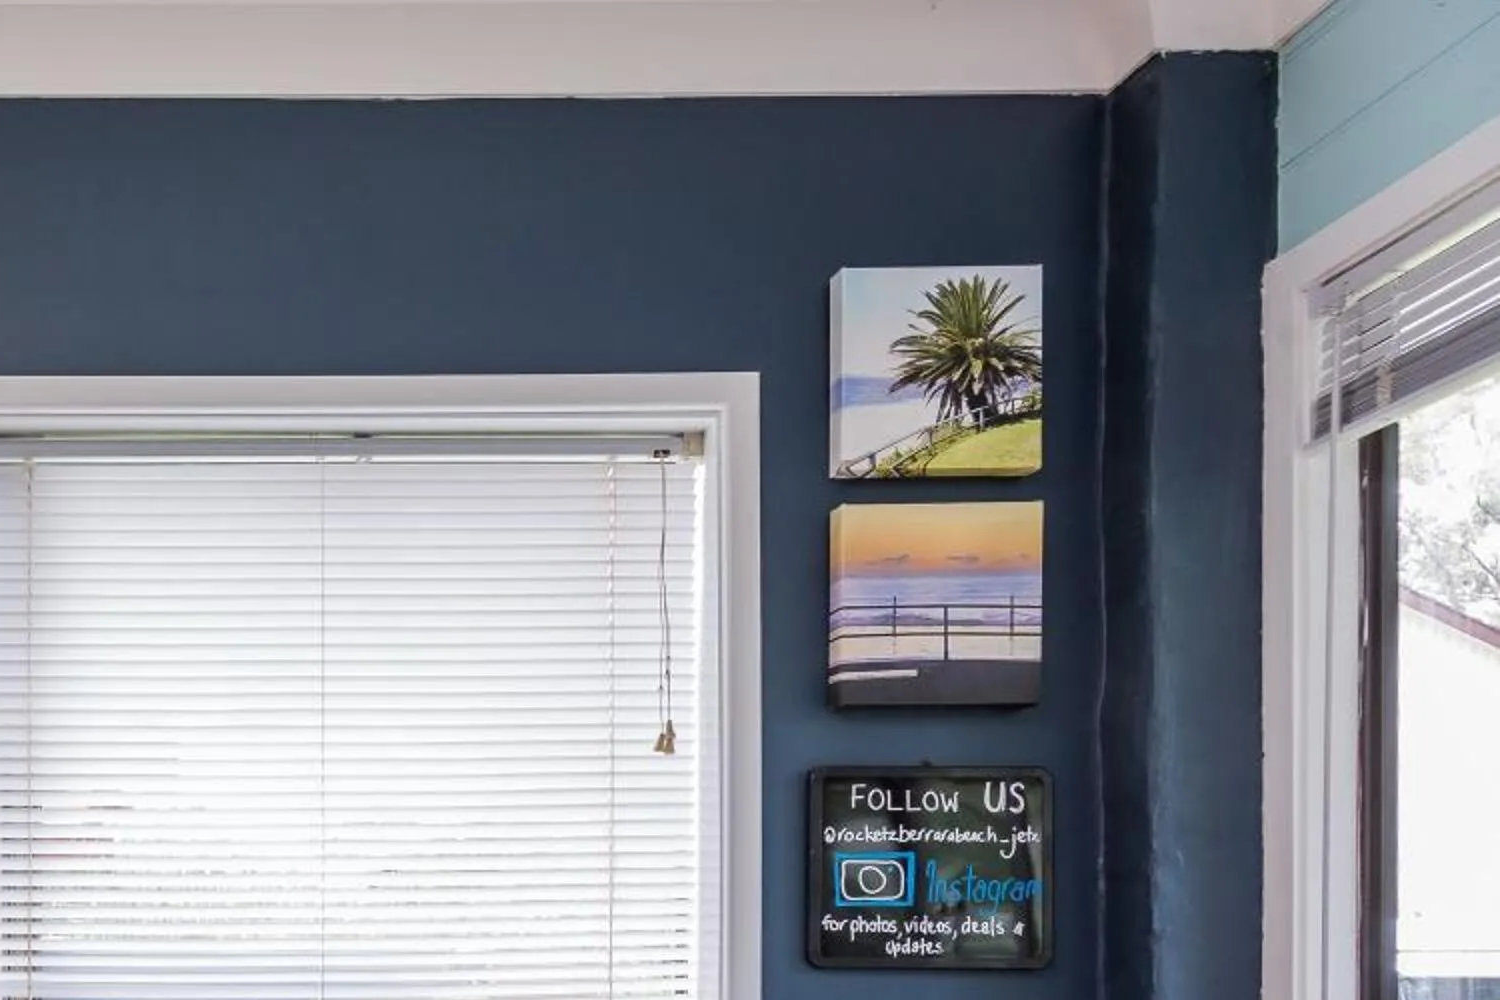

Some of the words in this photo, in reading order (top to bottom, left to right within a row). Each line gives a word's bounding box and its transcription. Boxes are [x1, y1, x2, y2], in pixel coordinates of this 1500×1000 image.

[851, 783, 960, 813] FOLLOW
[983, 781, 1026, 814] US
[925, 859, 1044, 915] Instagram
[821, 913, 849, 933] for
[850, 916, 902, 941] photos,
[904, 915, 957, 939] videos,
[961, 916, 1005, 937] deals
[885, 938, 943, 957] updates
